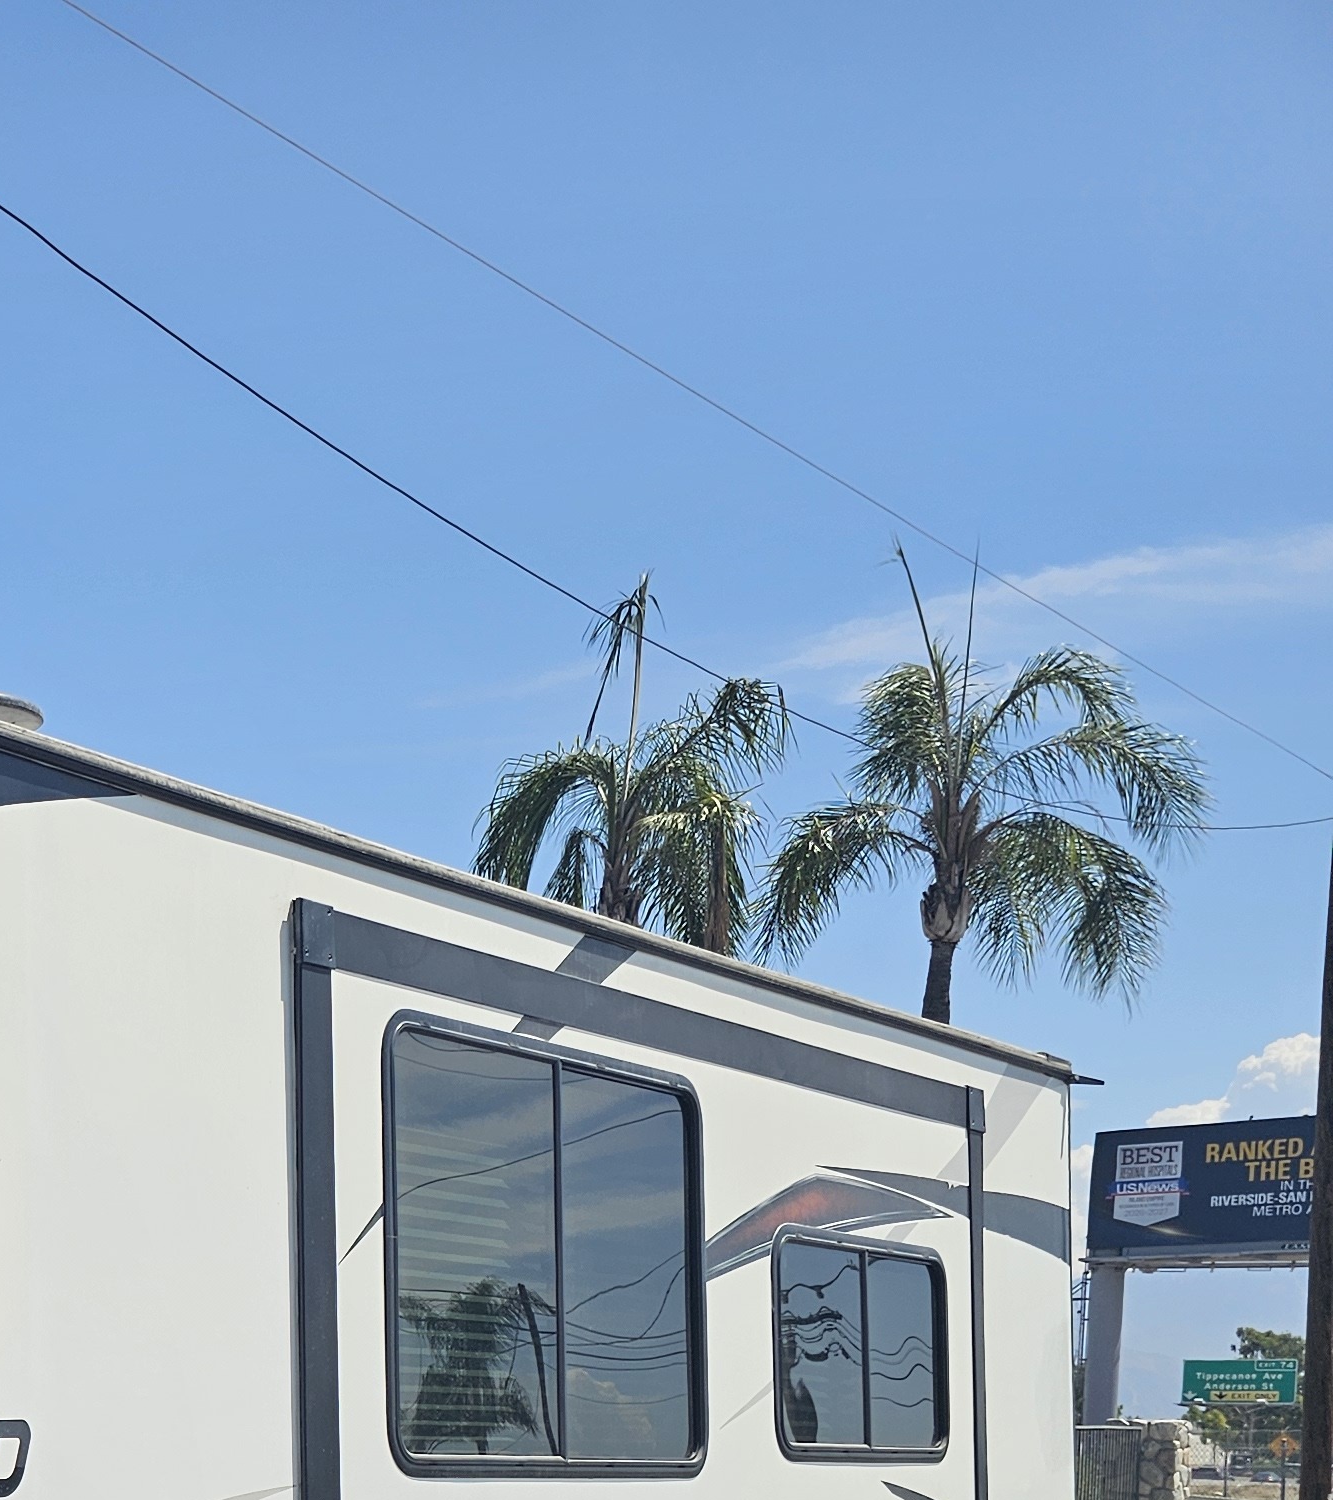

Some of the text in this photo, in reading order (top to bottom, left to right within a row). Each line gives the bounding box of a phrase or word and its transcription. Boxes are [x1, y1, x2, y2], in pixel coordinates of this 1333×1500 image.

[1120, 1146, 1178, 1165] BEST
[1205, 1138, 1303, 1163] RANKED
[1245, 1160, 1291, 1181] THE
[1280, 1181, 1293, 1190] IN
[1211, 1191, 1306, 1207] RIVERSIDE-SAN
[1252, 1204, 1302, 1216] METRO
[1280, 1361, 1294, 1369] 74
[1195, 1372, 1283, 1381] Tippecanoe Ave
[1203, 1382, 1274, 1390] Anderson St
[1255, 1392, 1277, 1400] ONLY
